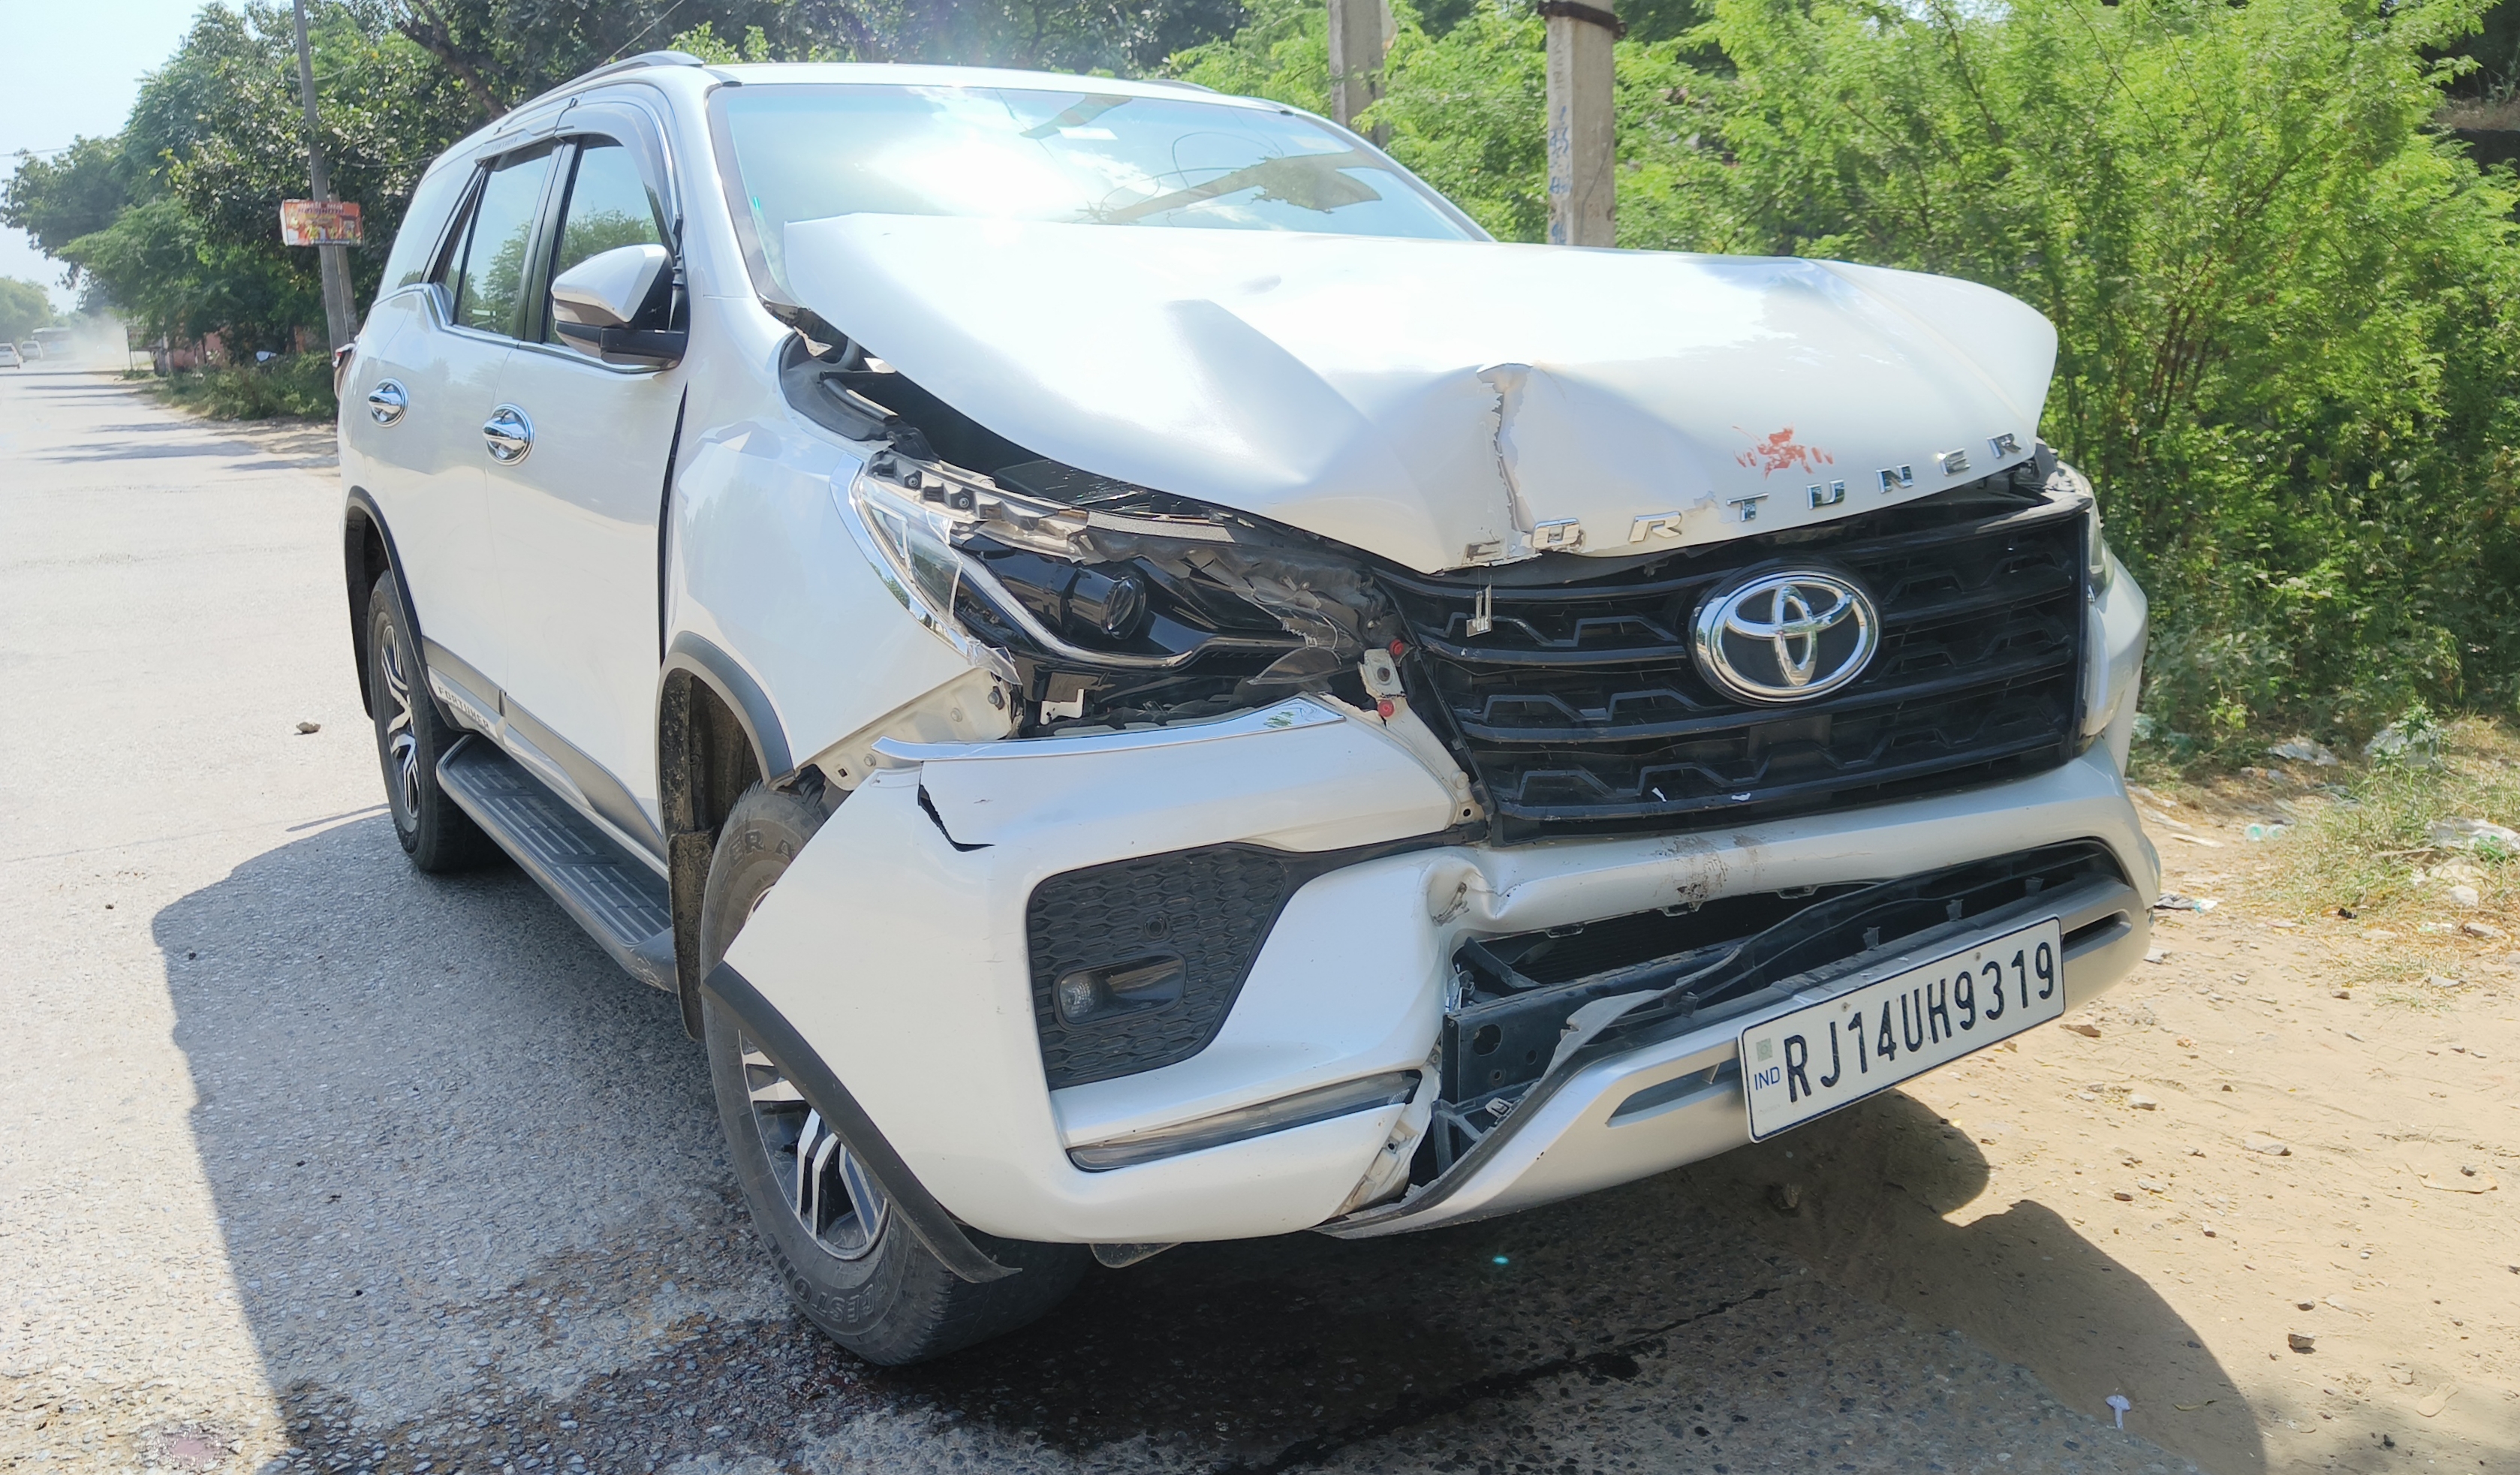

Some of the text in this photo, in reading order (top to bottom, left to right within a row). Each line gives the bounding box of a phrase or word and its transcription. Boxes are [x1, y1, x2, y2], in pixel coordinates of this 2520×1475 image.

[438, 686, 489, 730] FORTUNER
[1784, 941, 2054, 1103] RJ14UH9319
[1754, 1067, 1781, 1091] IND
